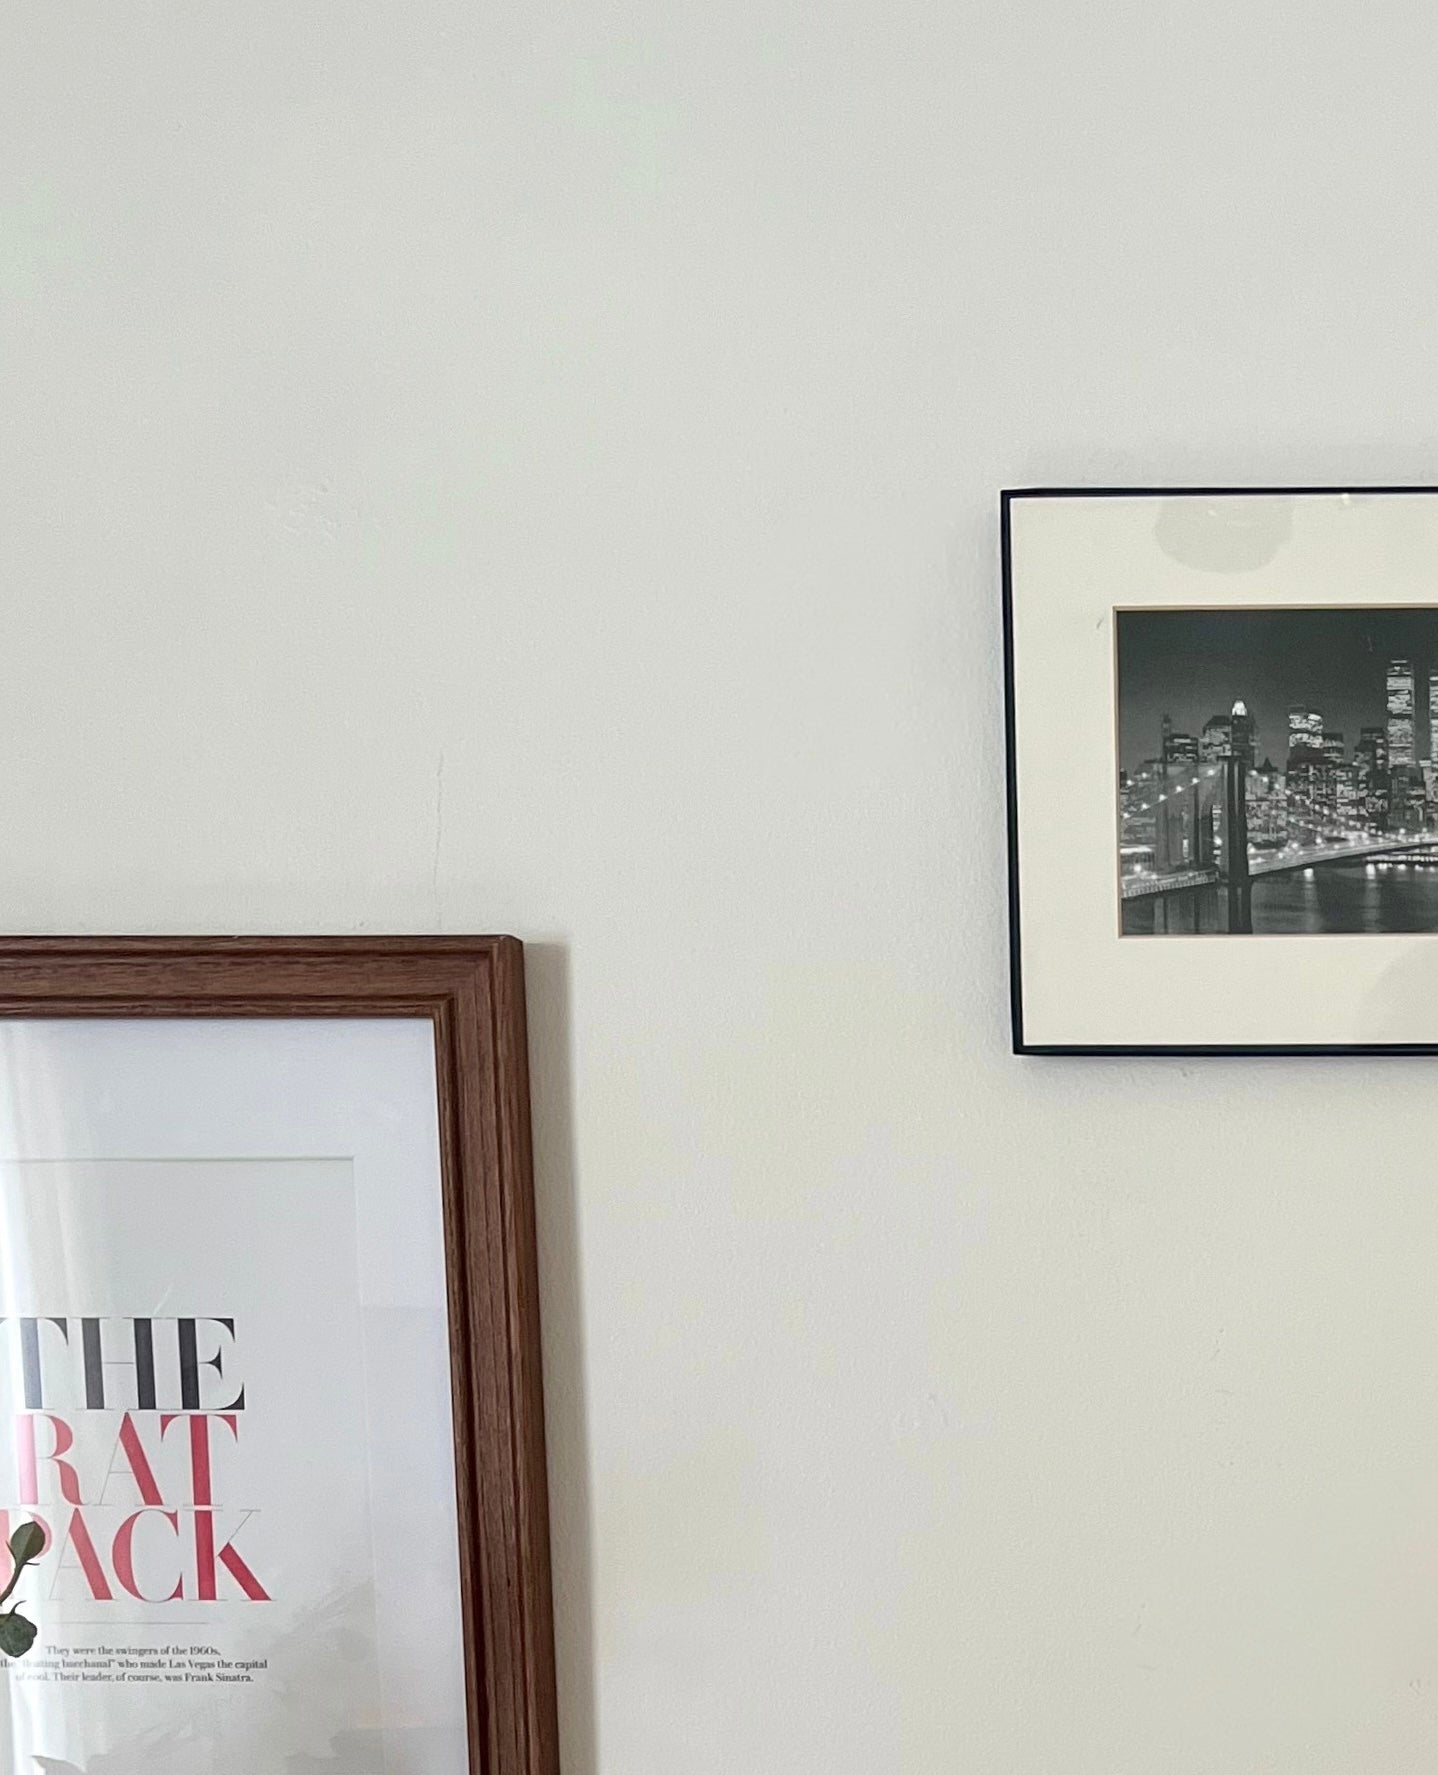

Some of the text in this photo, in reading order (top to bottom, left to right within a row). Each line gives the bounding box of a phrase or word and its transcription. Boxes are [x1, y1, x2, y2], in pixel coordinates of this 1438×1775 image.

[0, 1317, 246, 1411] THE
[15, 1411, 239, 1506] RAT
[46, 1645, 70, 1658] They
[73, 1647, 95, 1656] were
[98, 1645, 114, 1656] the
[115, 1646, 158, 1658] swingers
[160, 1645, 171, 1656] of
[172, 1645, 188, 1656] the
[117, 1658, 139, 1669] who
[140, 1658, 167, 1669] made
[168, 1659, 187, 1669] Las
[188, 1659, 216, 1671] Vegas
[217, 1658, 233, 1669] the
[234, 1658, 268, 1672] capital
[54, 1671, 80, 1681] Their
[115, 1671, 127, 1681] of
[164, 1673, 183, 1682] was
[184, 1671, 214, 1682] Frank
[215, 1671, 254, 1682] Sinatra.
